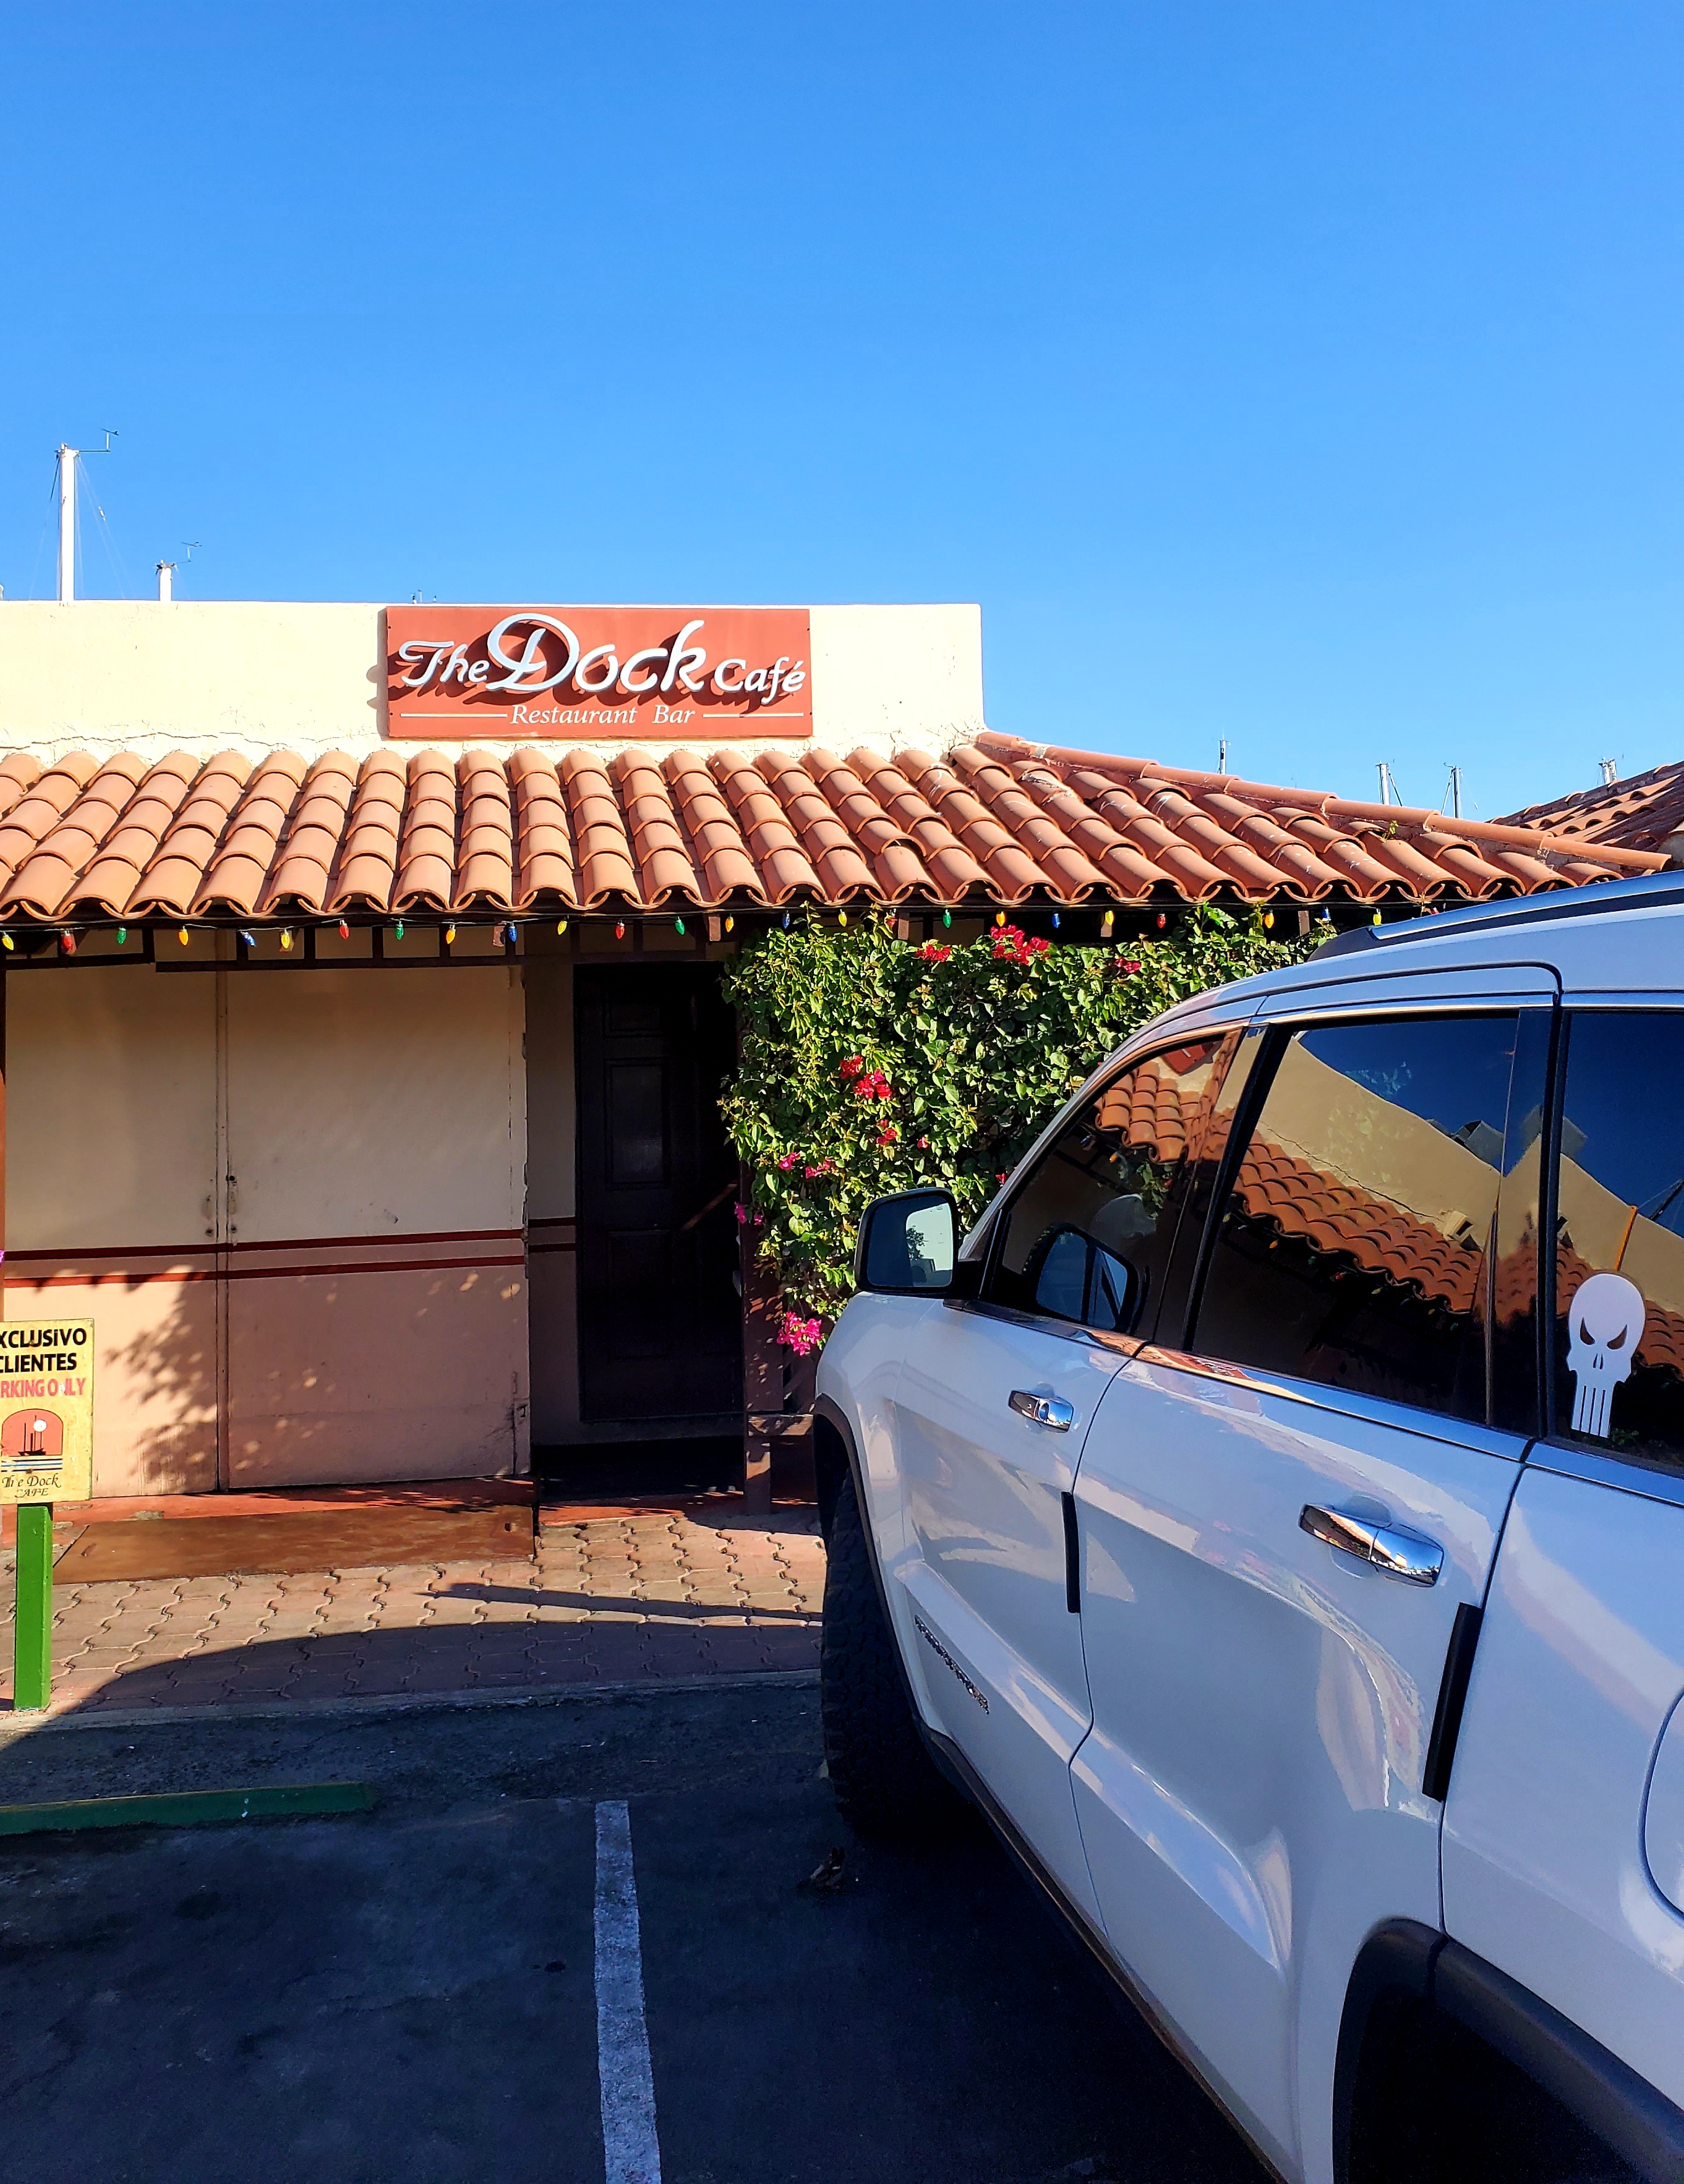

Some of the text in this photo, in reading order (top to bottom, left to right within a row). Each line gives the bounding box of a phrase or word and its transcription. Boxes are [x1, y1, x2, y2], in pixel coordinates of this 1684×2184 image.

[399, 613, 805, 704] The Dock Café
[510, 704, 695, 725] Restaurant Bar
[27, 1473, 62, 1488] Dock
